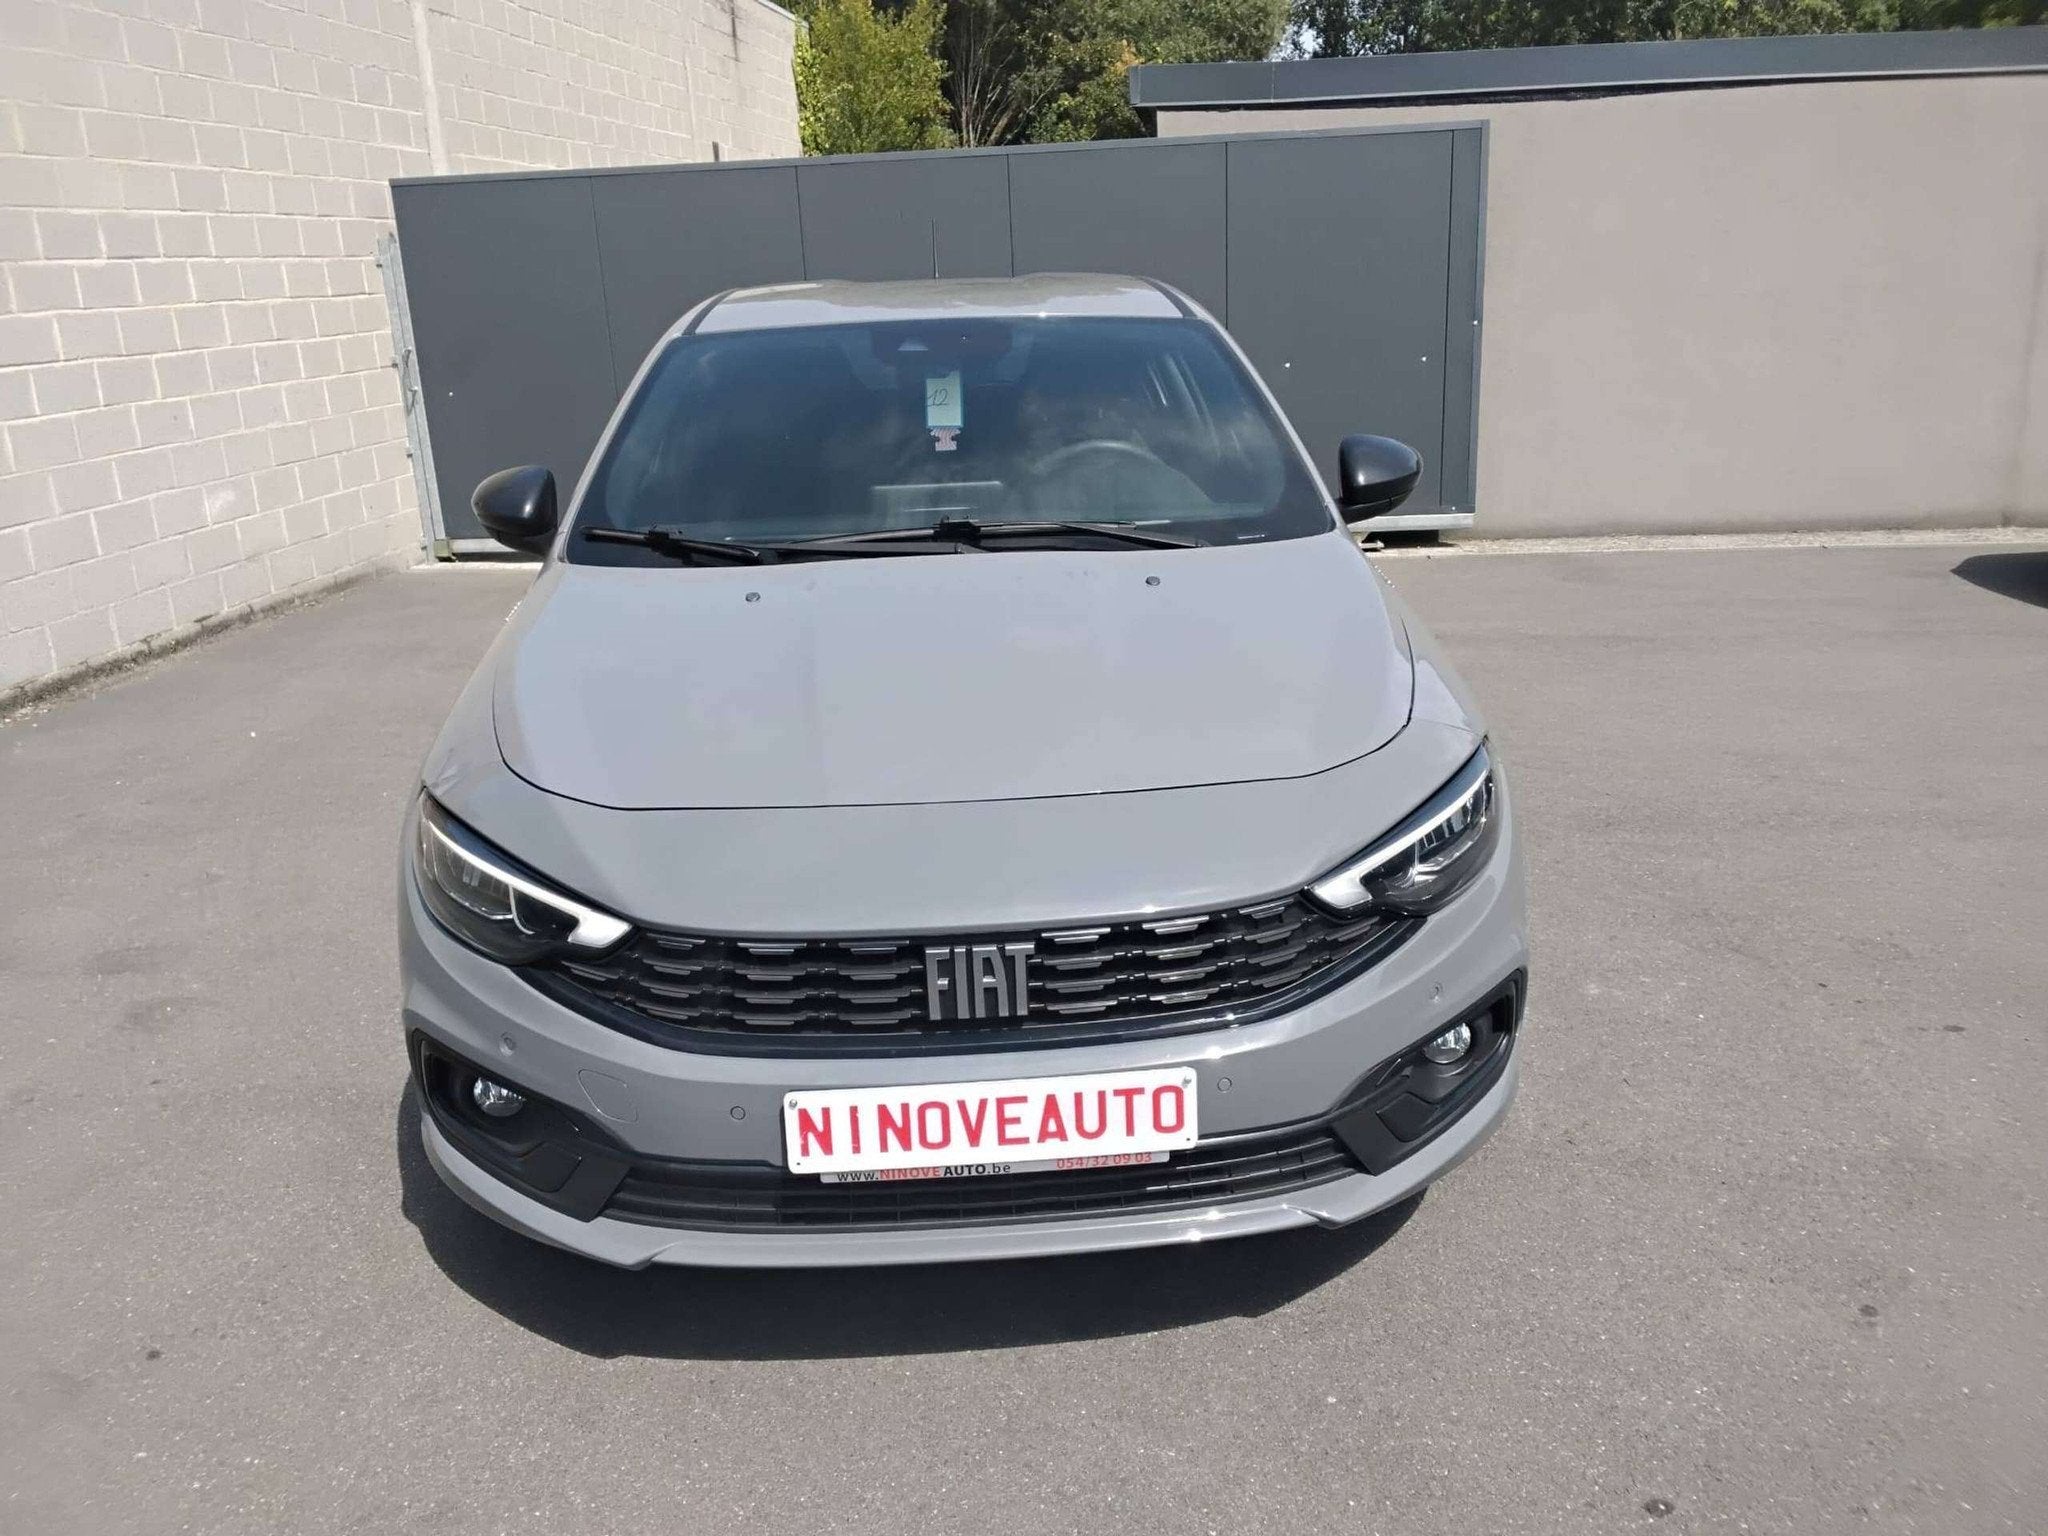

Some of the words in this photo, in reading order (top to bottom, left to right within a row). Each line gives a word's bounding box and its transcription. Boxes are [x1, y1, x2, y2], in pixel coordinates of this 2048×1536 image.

[925, 942, 1035, 1020] FIAT
[799, 1085, 1185, 1157] NINOVEAUTO
[837, 1163, 1011, 1182] www.NINOVEAUTO.be
[1056, 1156, 1109, 1169] 054/32
[1113, 1153, 1130, 1164] 09
[1135, 1152, 1152, 1163] 03
